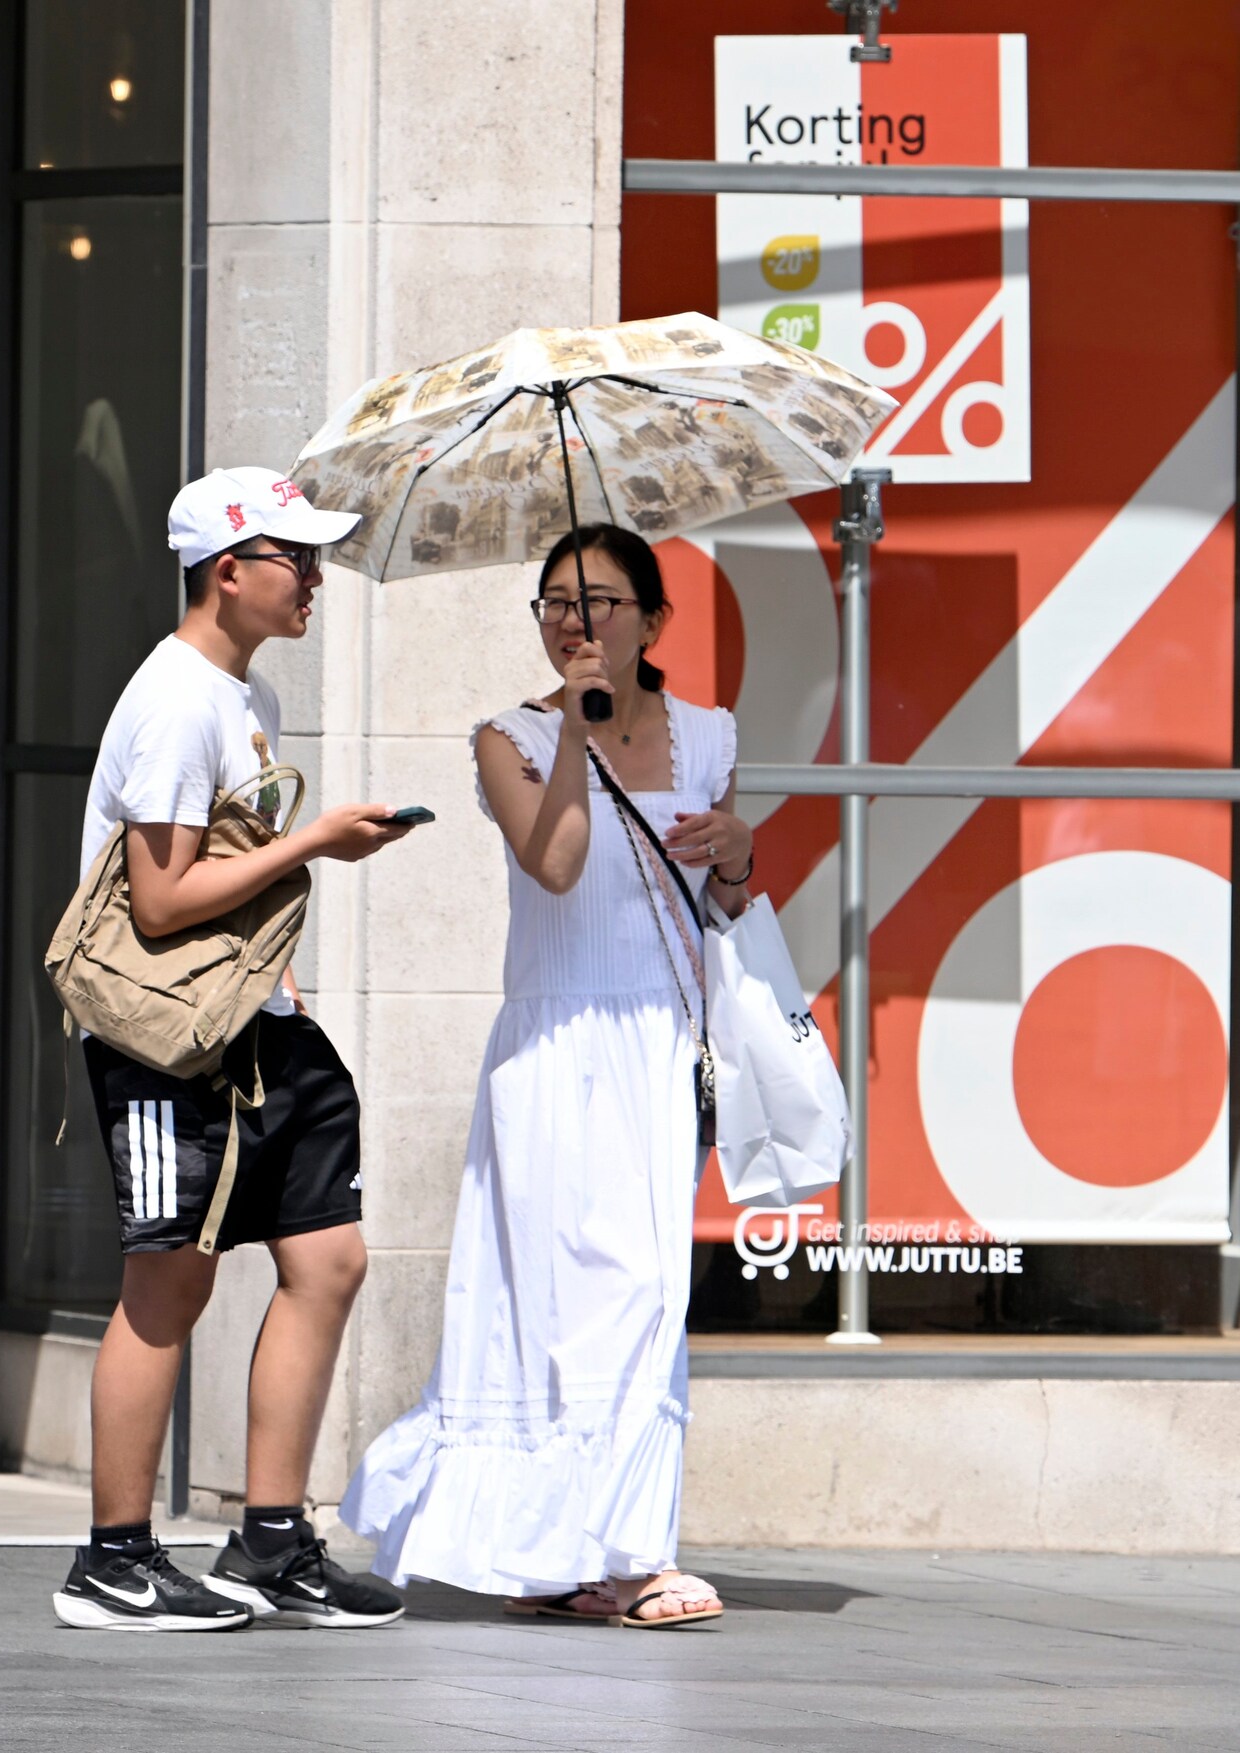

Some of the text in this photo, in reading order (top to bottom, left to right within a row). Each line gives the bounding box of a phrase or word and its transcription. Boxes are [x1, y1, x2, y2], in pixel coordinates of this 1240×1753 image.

[746, 104, 926, 155] Korting
[767, 247, 814, 276] -20%
[767, 314, 815, 344] -30%
[806, 1218, 844, 1242] Get
[851, 1219, 940, 1246] inspired
[944, 1219, 962, 1244] &
[805, 1245, 1024, 1274] WWW.JUTTU.BE
